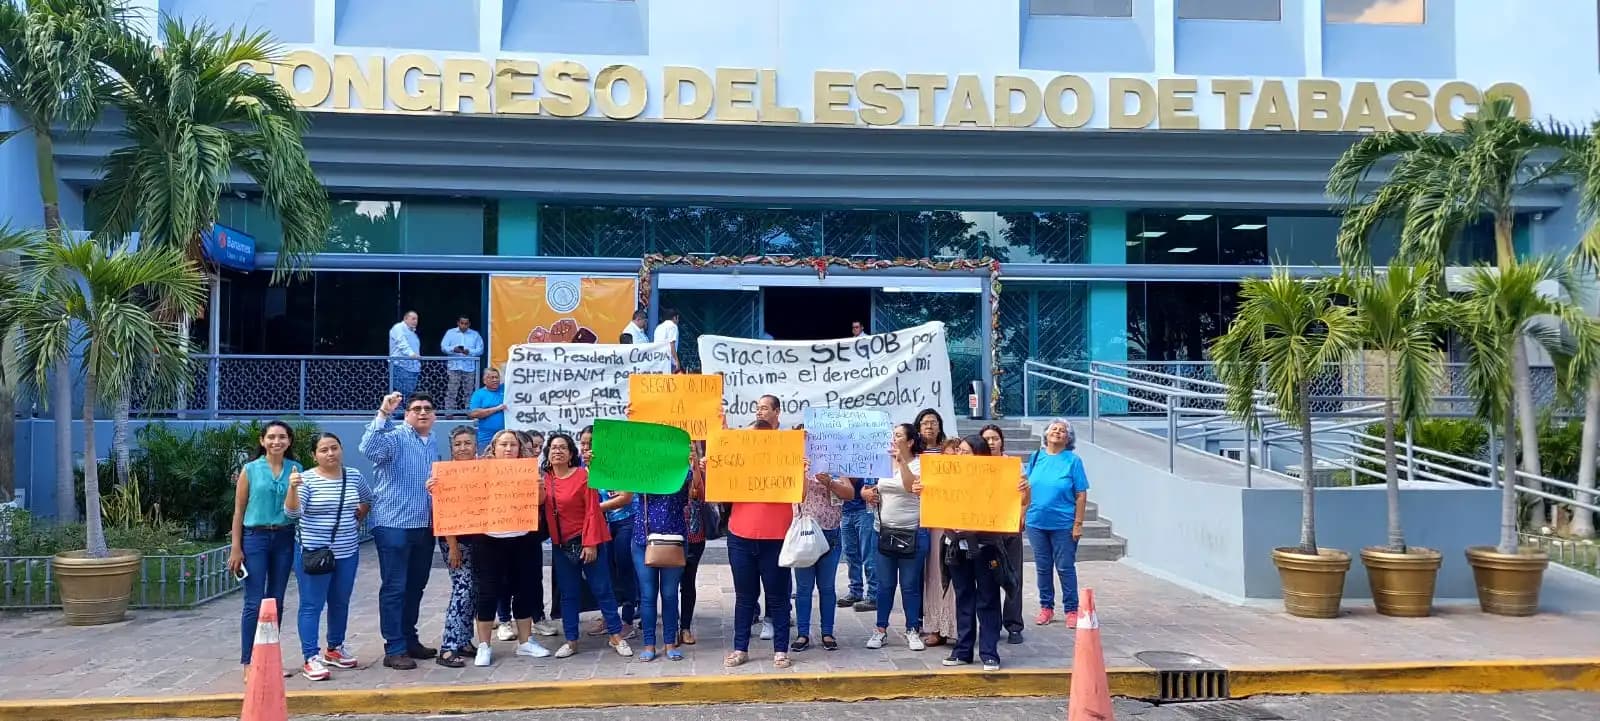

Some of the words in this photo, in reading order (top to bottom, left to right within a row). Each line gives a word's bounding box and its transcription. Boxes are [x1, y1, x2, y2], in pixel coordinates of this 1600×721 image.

[663, 66, 799, 123] DEL
[813, 70, 1095, 128] ESTADO
[1108, 78, 1199, 129] DE
[1211, 79, 1532, 134] TABASCO
[511, 347, 547, 362] Sra.
[553, 346, 624, 366] Presidenta
[712, 342, 799, 365] Gracias
[810, 333, 900, 363] SEGOB
[912, 330, 938, 351] por
[798, 364, 817, 383] el
[823, 361, 889, 383] derecho
[896, 360, 912, 373] a
[915, 354, 931, 372] mi
[513, 391, 532, 404] su
[539, 388, 581, 406] apoyo
[590, 387, 623, 404] para
[720, 391, 810, 416] edución
[825, 376, 926, 409] Preescolar,
[931, 380, 942, 408] y
[515, 407, 552, 423] esta
